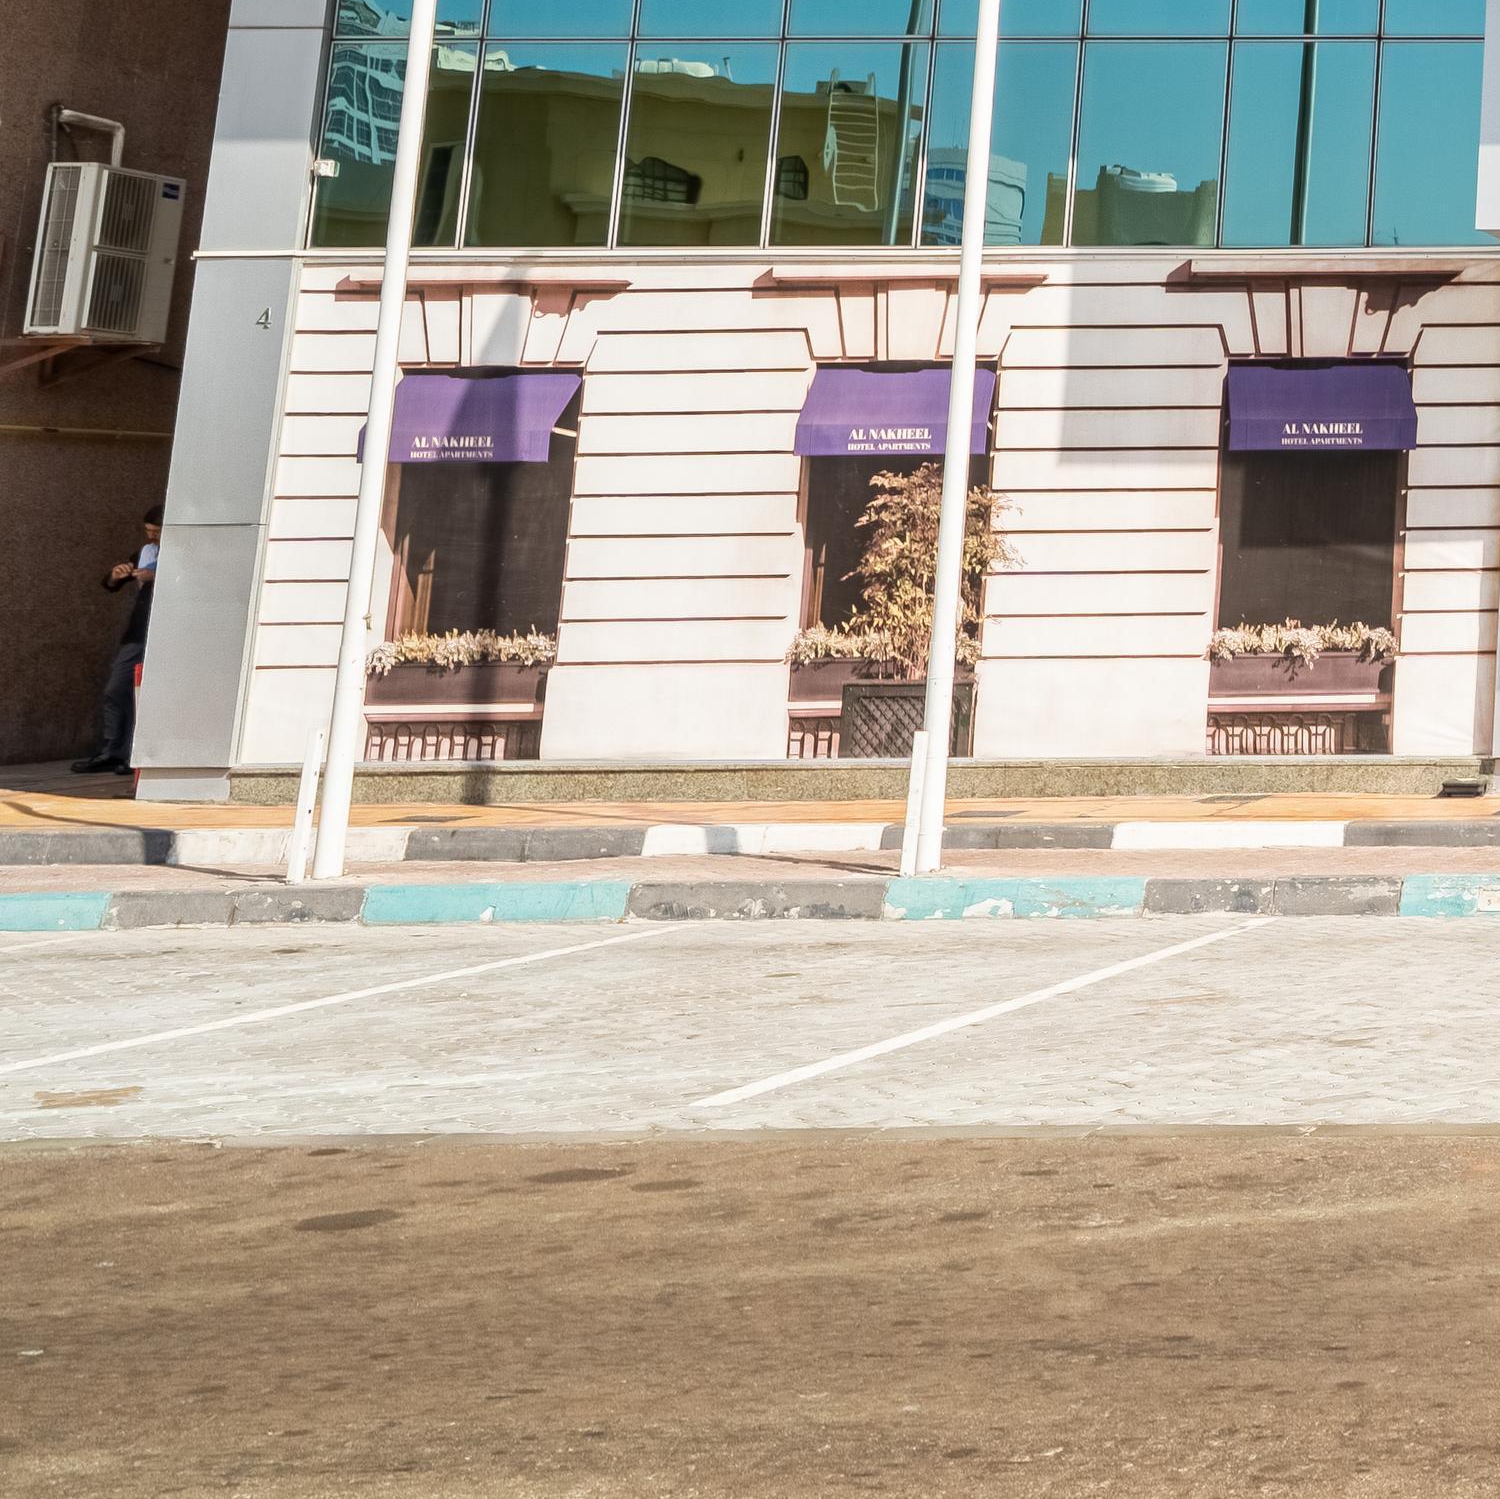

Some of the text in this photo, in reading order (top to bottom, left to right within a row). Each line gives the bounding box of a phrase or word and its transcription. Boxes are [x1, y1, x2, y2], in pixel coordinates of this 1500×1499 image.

[255, 307, 272, 330] 4
[848, 428, 931, 440] AL NAKHEEL
[1283, 422, 1363, 435] AL NAKHEEL
[411, 436, 494, 448] AL NAKHEEL
[847, 442, 931, 451] HOTEL APARTMENTS
[440, 451, 493, 459] APARTMENTS
